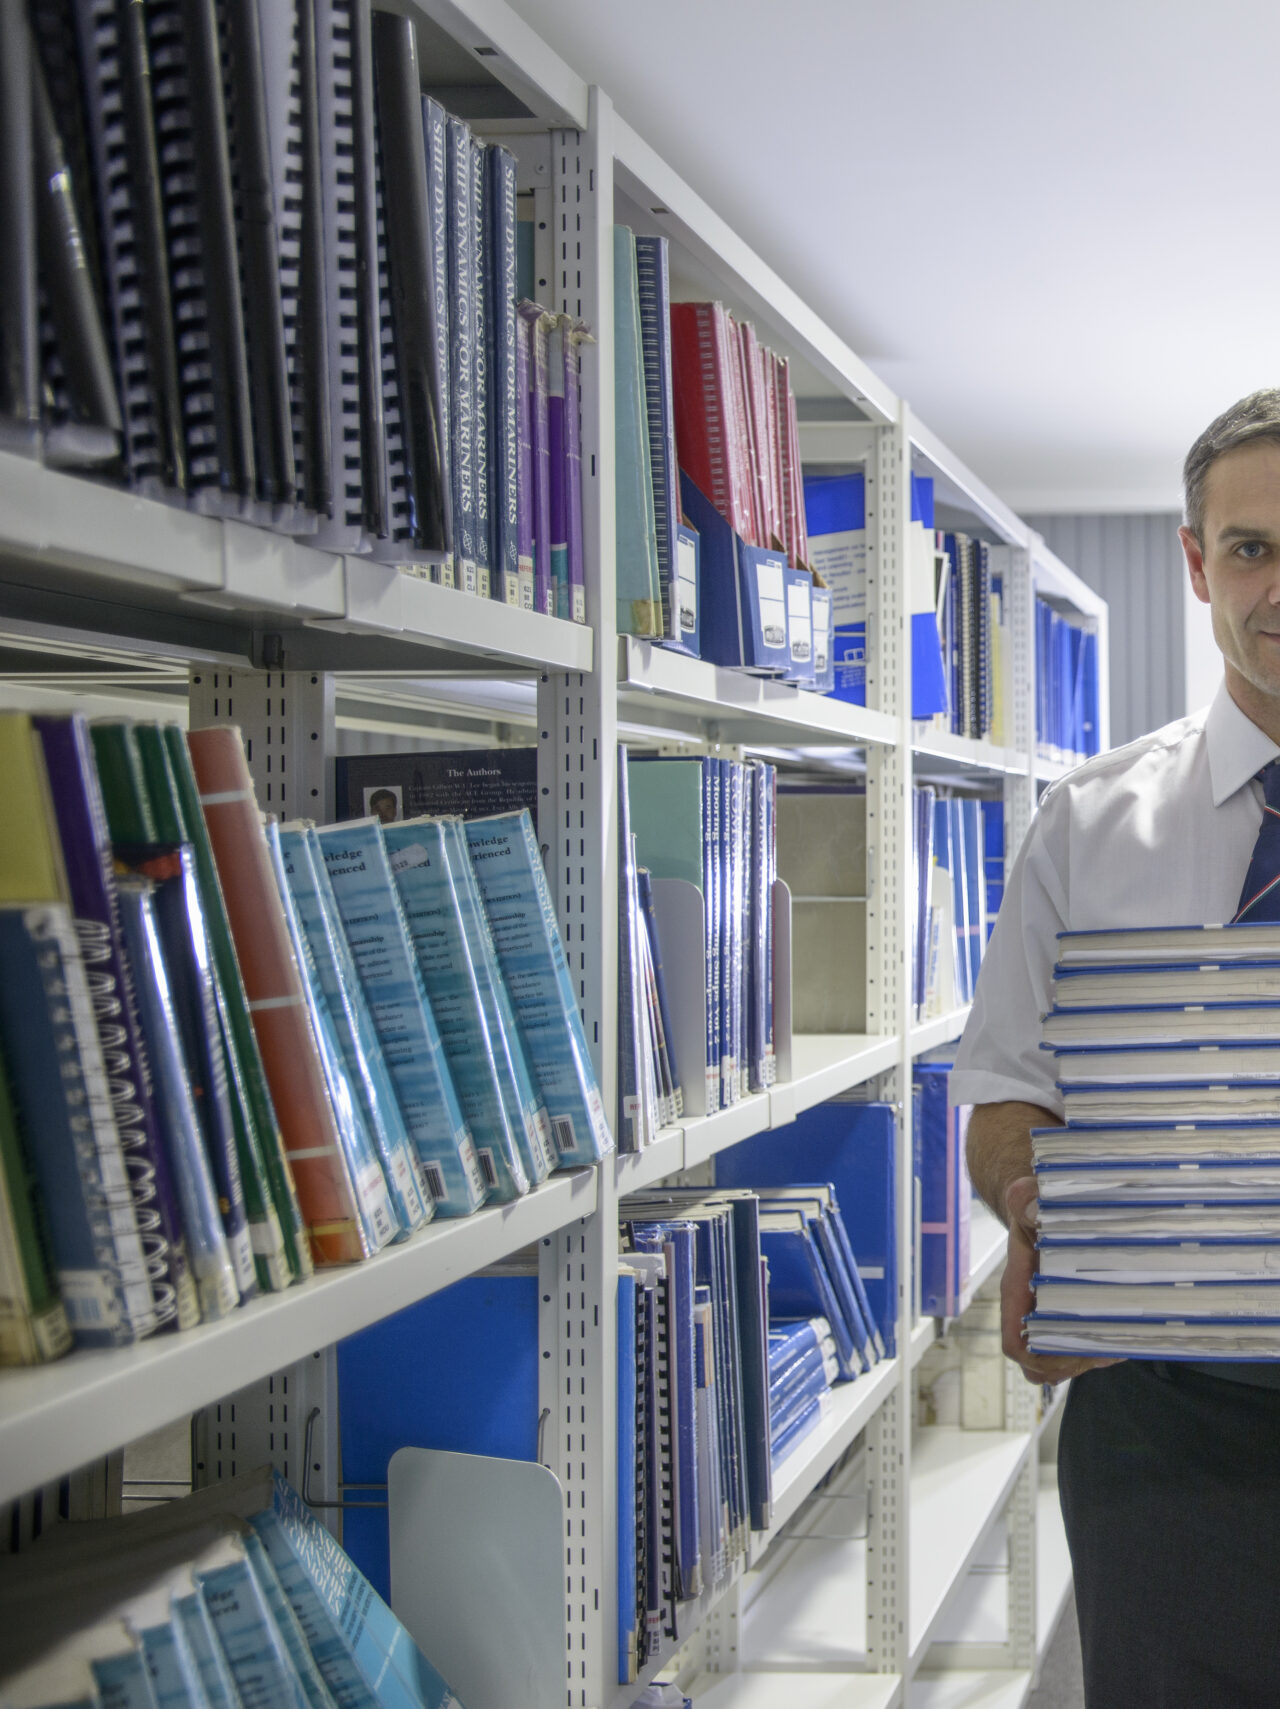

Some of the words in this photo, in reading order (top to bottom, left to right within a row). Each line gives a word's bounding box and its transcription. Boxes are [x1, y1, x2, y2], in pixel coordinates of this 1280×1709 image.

[434, 120, 443, 182] SHIP
[456, 136, 465, 195] SHIP
[474, 152, 482, 210] SHIP
[505, 166, 513, 223] SHIP
[434, 187, 444, 315] DYNAMICS
[457, 200, 468, 326] DYNAMICS
[474, 216, 483, 338] DYNAMICS
[506, 227, 515, 348] DYNAMICS
[458, 333, 469, 382] FOR
[477, 344, 486, 393] FOR
[507, 353, 515, 400] FOR
[460, 389, 472, 512] MARINERS
[477, 400, 487, 519] MARINERS
[508, 406, 517, 524] MARINERS
[447, 769, 464, 777] The
[467, 768, 501, 776] Authors
